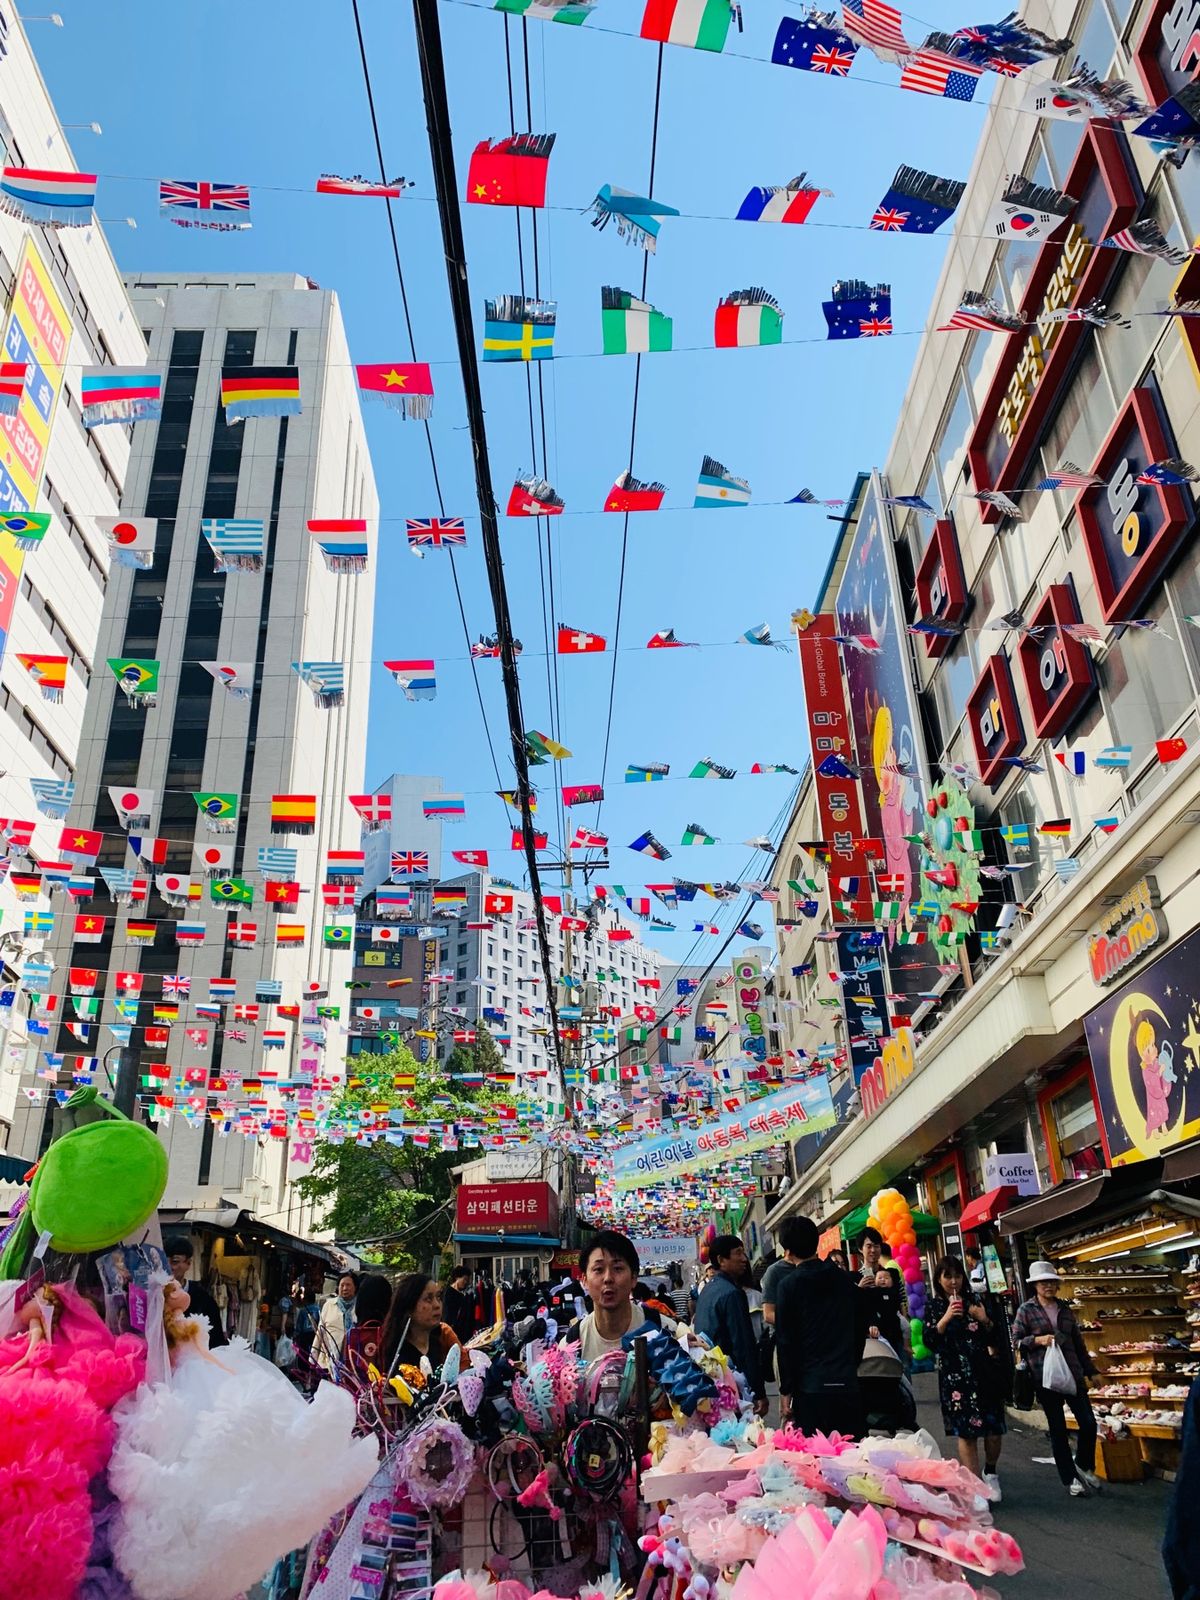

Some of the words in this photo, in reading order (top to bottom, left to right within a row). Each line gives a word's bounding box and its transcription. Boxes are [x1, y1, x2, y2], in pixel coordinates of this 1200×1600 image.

[24, 267, 65, 361] 악세서리
[813, 632, 821, 648] Best
[815, 648, 825, 671] Global
[818, 673, 828, 697] Brands
[980, 695, 1000, 747] 마
[1039, 636, 1065, 690] 아
[813, 711, 855, 861] 마마동복
[1106, 911, 1157, 973] mama
[861, 1027, 914, 1120] mama
[636, 1140, 696, 1170] 어린이날
[697, 1122, 748, 1152] 아동복
[749, 1101, 807, 1134] 대축제
[999, 1165, 1034, 1177] Coffee
[466, 1199, 538, 1215] 삼익패션타운
[135, 1295, 145, 1325] ARIA
